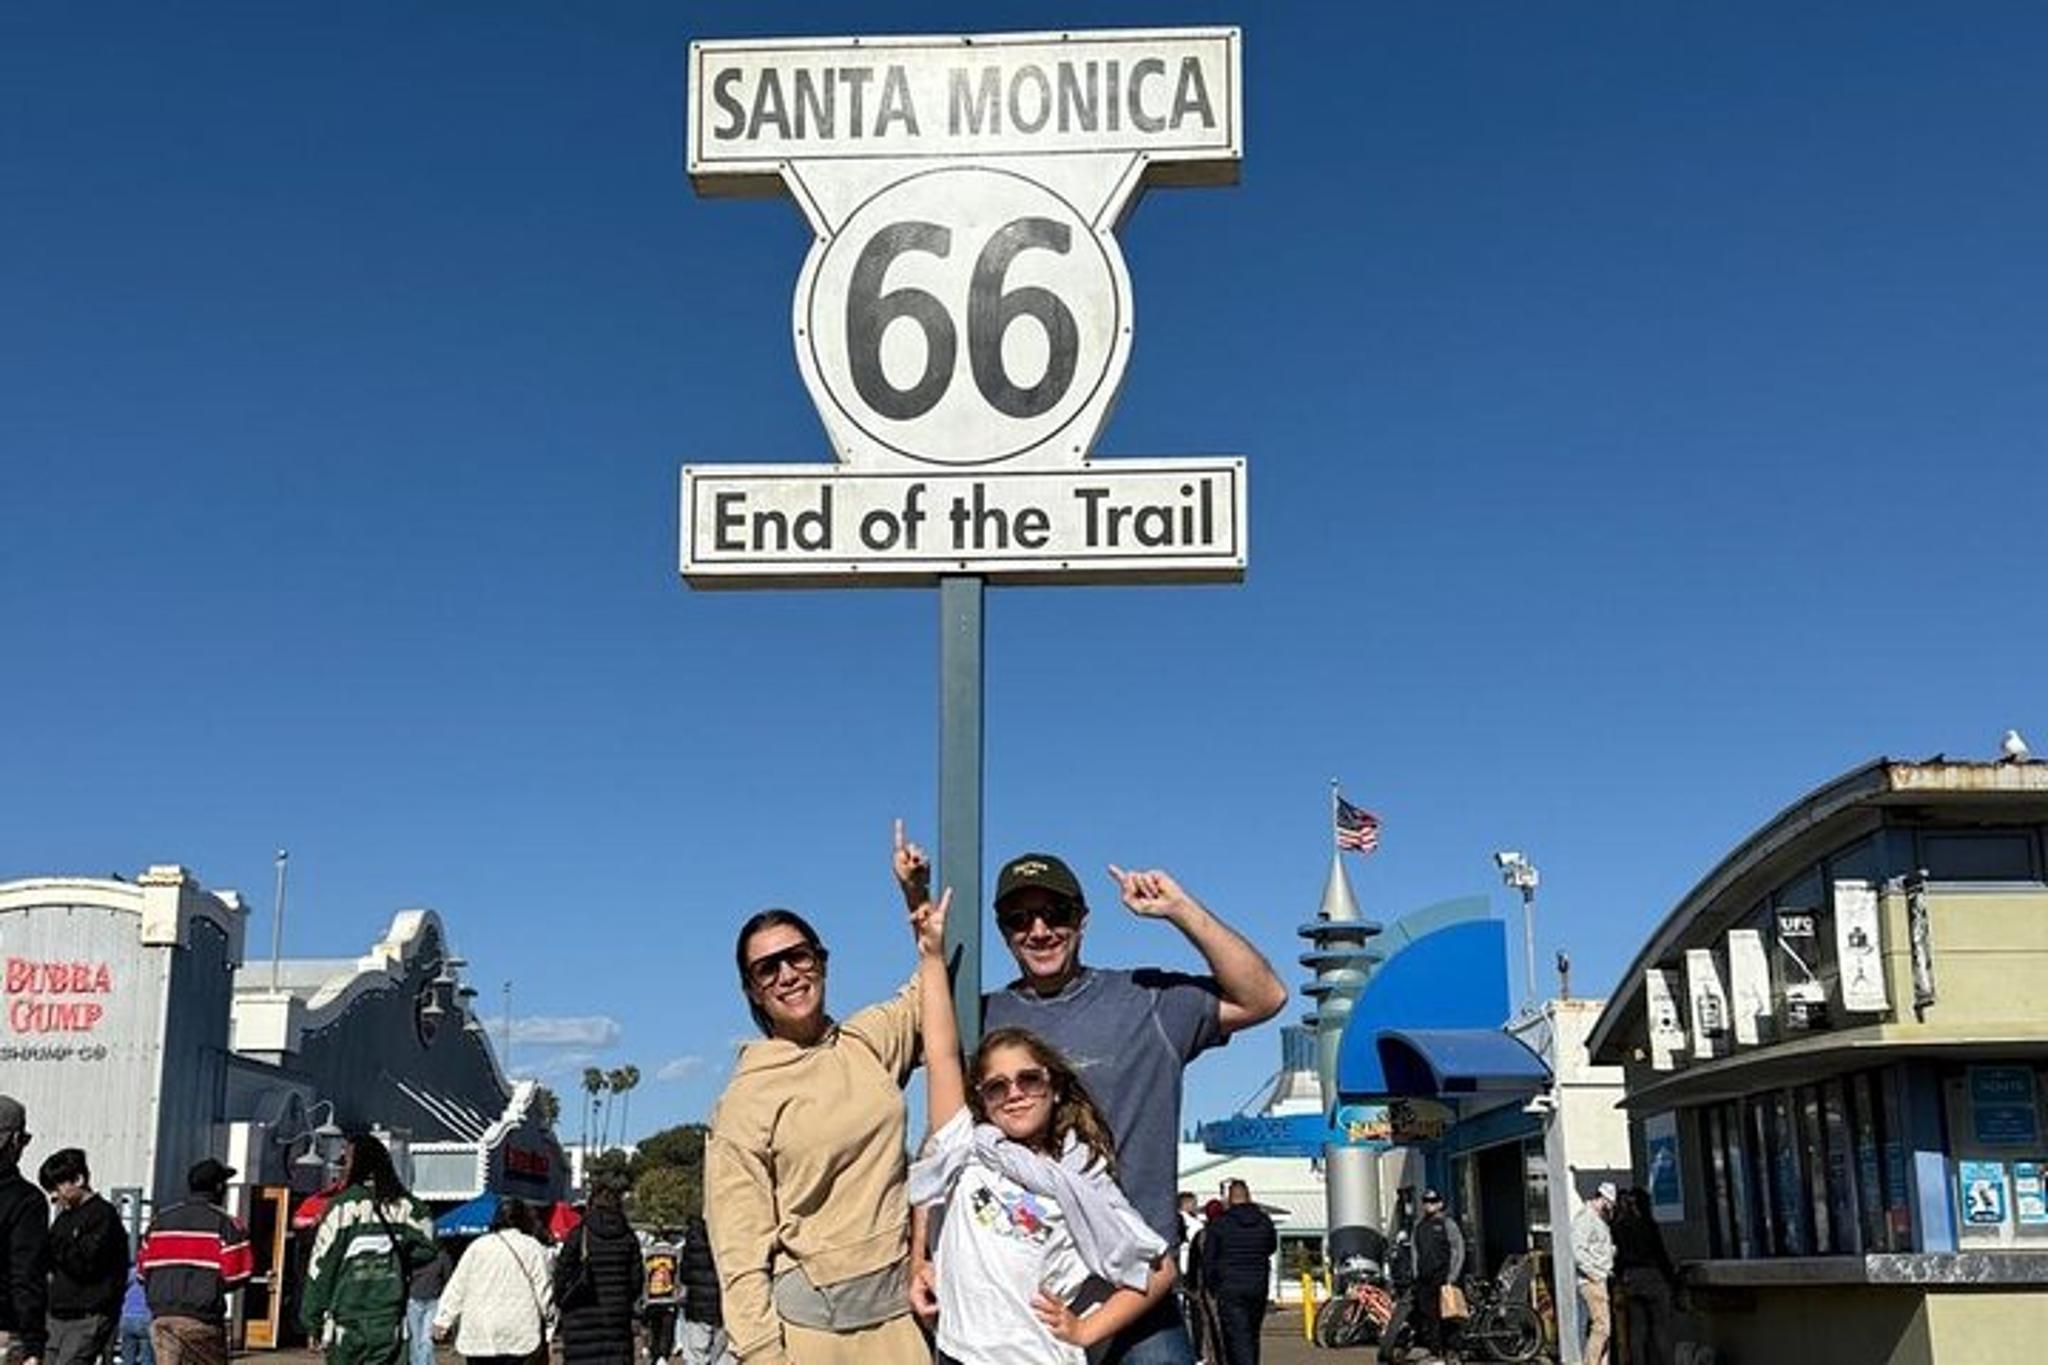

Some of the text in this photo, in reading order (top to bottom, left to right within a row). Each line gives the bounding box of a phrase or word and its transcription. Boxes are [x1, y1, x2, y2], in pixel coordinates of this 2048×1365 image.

[714, 56, 1217, 141] SANTA MONICA
[846, 217, 1080, 422] 66
[714, 478, 1215, 553] End of the Trail
[5, 957, 112, 994] BUBBA
[9, 1000, 104, 1034] GUMP
